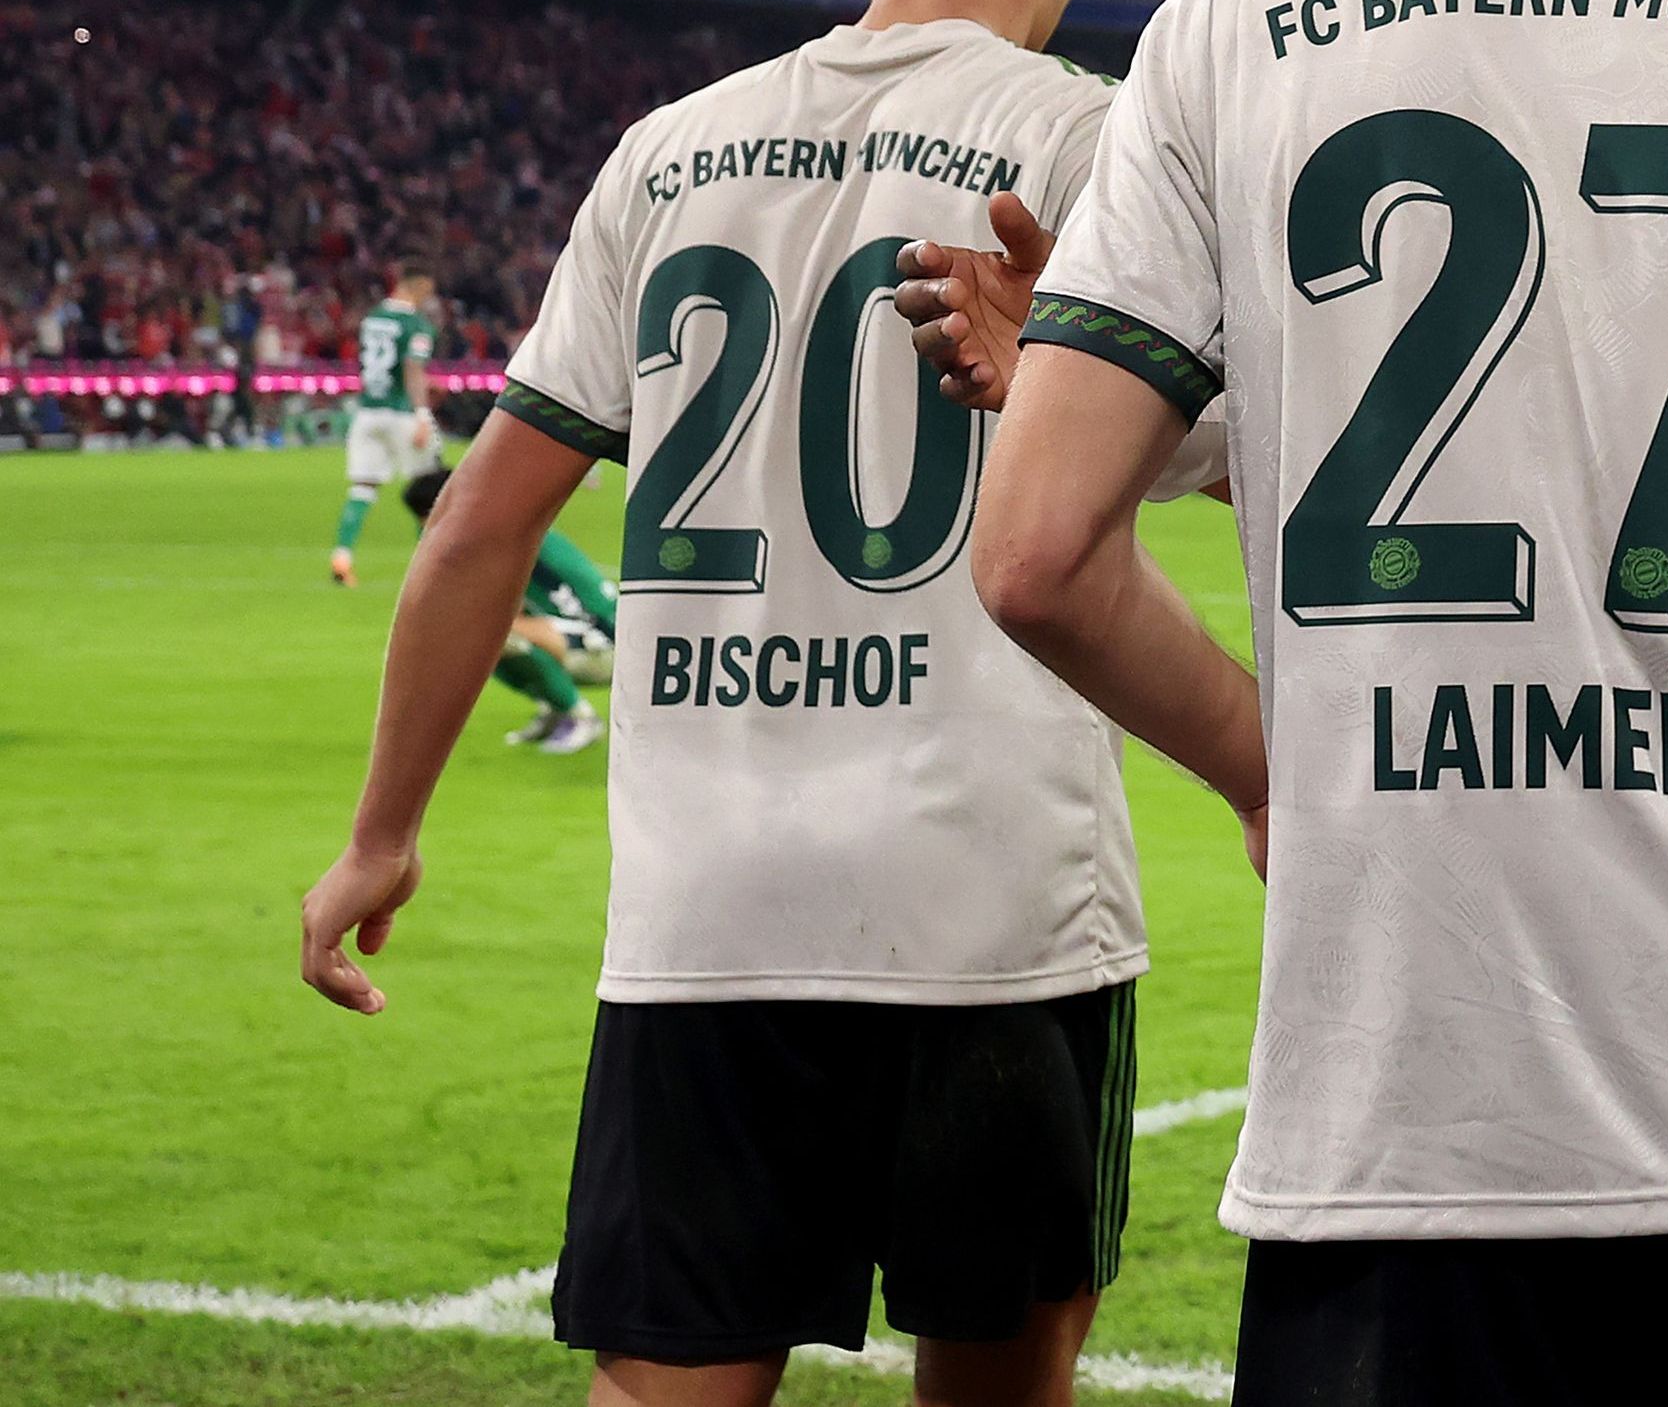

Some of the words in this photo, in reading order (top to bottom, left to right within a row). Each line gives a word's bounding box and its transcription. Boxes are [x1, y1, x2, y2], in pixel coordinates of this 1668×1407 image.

[646, 162, 682, 206] FC
[691, 137, 847, 189] BAYERN
[619, 236, 985, 593] 20
[651, 632, 929, 708] BISCHOF
